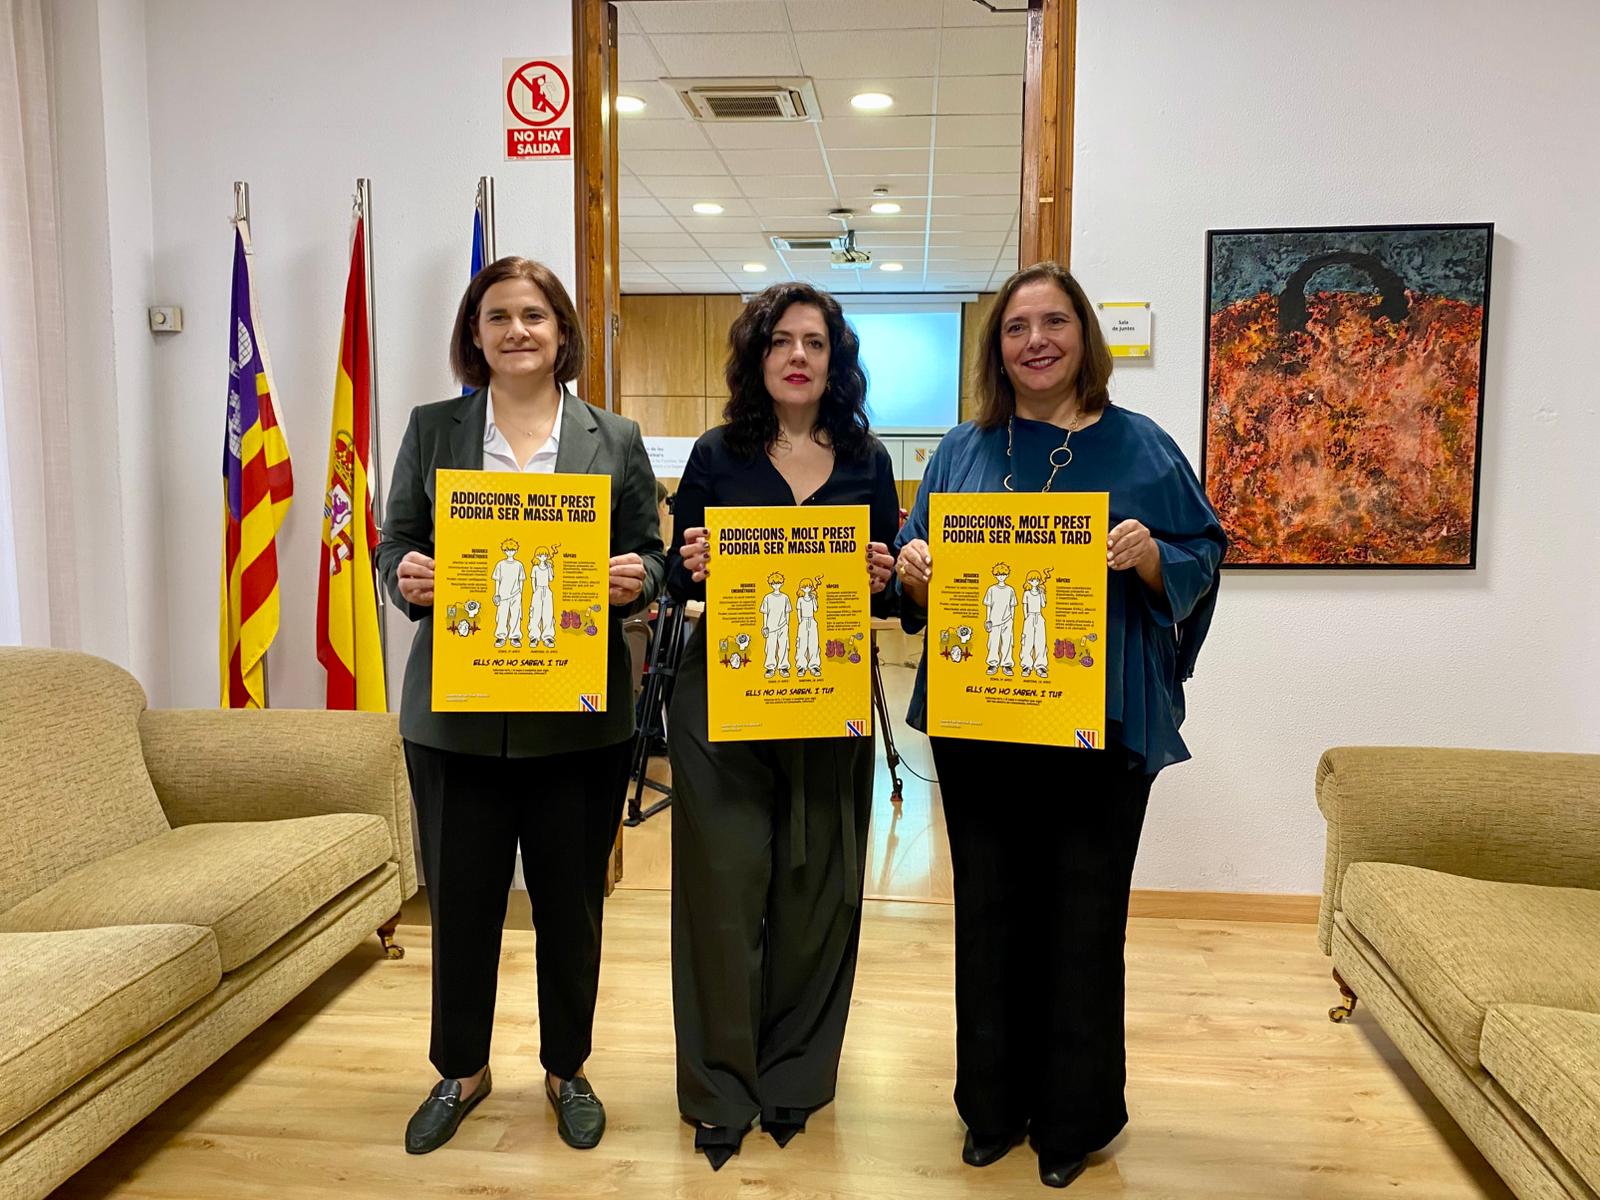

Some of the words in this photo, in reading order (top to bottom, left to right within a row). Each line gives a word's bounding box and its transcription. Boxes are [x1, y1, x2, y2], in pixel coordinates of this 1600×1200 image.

[513, 131, 534, 142] NO
[537, 130, 563, 141] HAY
[517, 143, 560, 154] SALIDA
[451, 491, 524, 508] ADDICCIONS,
[527, 494, 557, 507] MOLT
[561, 495, 595, 508] PREST
[450, 506, 494, 520] PODRIA
[497, 508, 519, 520] SER
[523, 508, 563, 521] MASSA
[567, 509, 596, 522] TARD
[943, 515, 1015, 530] ADDICCIONS,
[1018, 516, 1050, 529] MOLT
[1053, 516, 1091, 529] PREST
[720, 527, 788, 541] ADDICCIONS,
[791, 527, 819, 540] MOLT
[822, 526, 855, 539] PREST
[943, 530, 985, 543] PODRIA
[989, 530, 1011, 544] SER
[1014, 531, 1056, 544] MASSA
[1060, 531, 1092, 545] TARD
[719, 542, 760, 555] PODRIA
[763, 541, 784, 554] SER
[788, 540, 826, 554] MASSA
[829, 540, 857, 553] TARD
[520, 659, 545, 667] SABEN.
[1012, 688, 1037, 696] SABEN.
